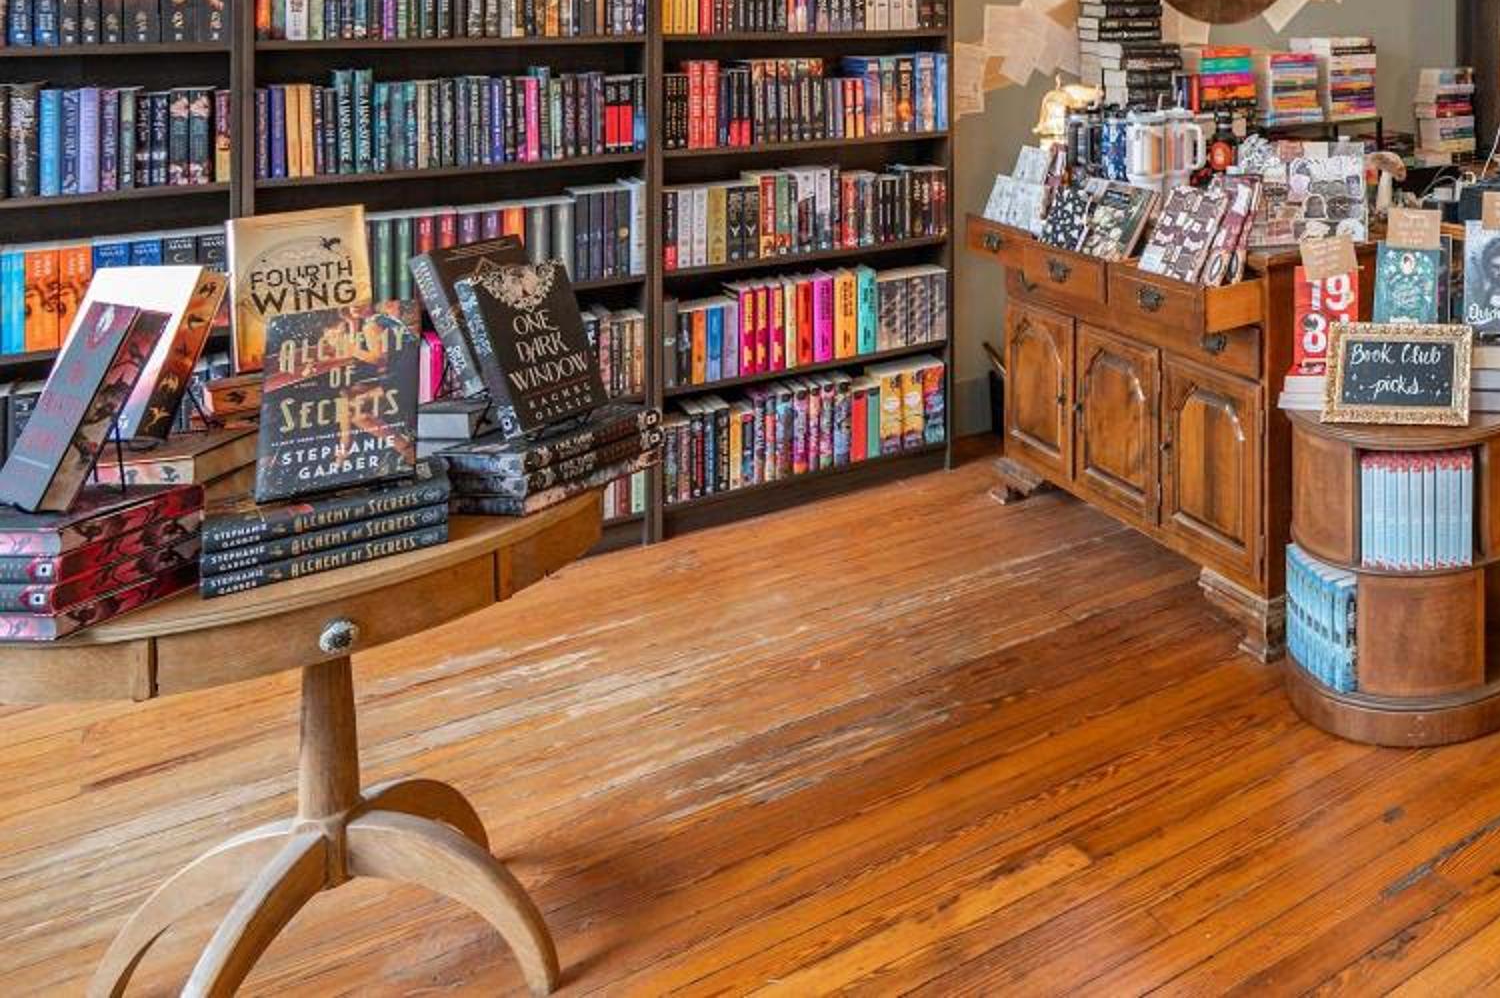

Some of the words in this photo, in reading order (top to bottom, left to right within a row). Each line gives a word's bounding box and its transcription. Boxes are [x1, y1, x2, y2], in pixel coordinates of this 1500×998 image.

[251, 259, 353, 291] FOURTH
[251, 280, 357, 315] WING
[512, 308, 559, 335] ONE
[279, 328, 404, 374] ALCHEMY
[515, 331, 570, 363] DARK
[1351, 344, 1396, 366] Book
[1401, 343, 1442, 365] Club
[329, 365, 357, 388] OF
[508, 351, 588, 391] WINDOW
[1368, 376, 1421, 398] picks
[279, 389, 399, 433] SECRETS
[281, 434, 396, 466] STEPHANIE
[298, 455, 380, 480] GARBER
[294, 506, 351, 533] ALCHEMY
[367, 492, 418, 516] SECRETS
[291, 530, 348, 556] ALCHEMY
[365, 512, 418, 538] SECRETS
[290, 552, 348, 578] ALCHEMY
[365, 536, 417, 560] SECRETS
